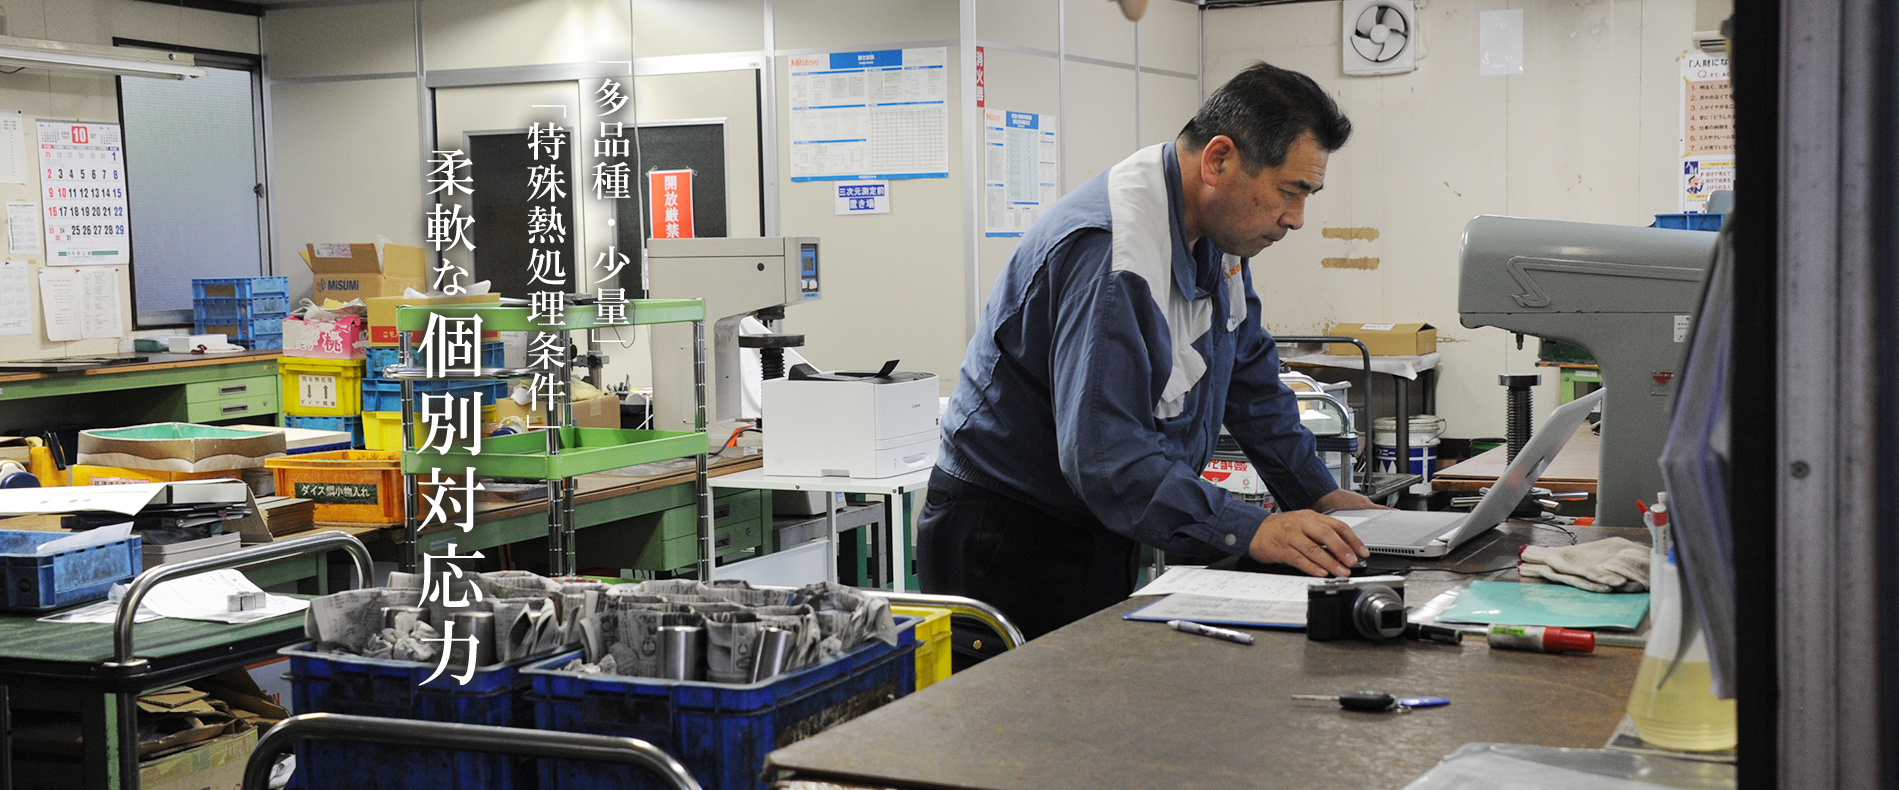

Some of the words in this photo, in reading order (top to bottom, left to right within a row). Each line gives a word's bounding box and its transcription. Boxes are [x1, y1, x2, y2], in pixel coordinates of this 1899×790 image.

[976, 51, 984, 102] 消火器
[73, 127, 86, 142] 10
[112, 151, 116, 161] 1
[47, 168, 52, 179] 2
[58, 168, 63, 179] 3
[69, 169, 74, 179] 4
[80, 169, 85, 179] 5
[91, 169, 96, 180] 6
[102, 169, 106, 179] 7
[113, 169, 118, 180] 8
[48, 187, 54, 198] 9
[57, 187, 67, 198] 10
[68, 188, 77, 198] 11
[79, 188, 88, 198] 12
[91, 188, 100, 198] 13
[101, 188, 111, 198] 14
[112, 188, 122, 198] 15
[839, 185, 885, 197] 三次元測定前
[664, 175, 680, 238] 開放厳禁
[849, 198, 875, 209] 置き場
[48, 206, 57, 217] 16
[59, 206, 68, 217] 17
[70, 206, 79, 216] 18
[81, 206, 90, 216] 19
[91, 206, 101, 216] 20
[102, 206, 111, 216] 21
[113, 206, 123, 217] 22
[71, 225, 80, 235] 25
[82, 225, 91, 235] 26
[93, 225, 102, 235] 27
[104, 225, 113, 235] 28
[115, 224, 124, 235] 29
[301, 485, 371, 497] ダイス鋼小物入れ
